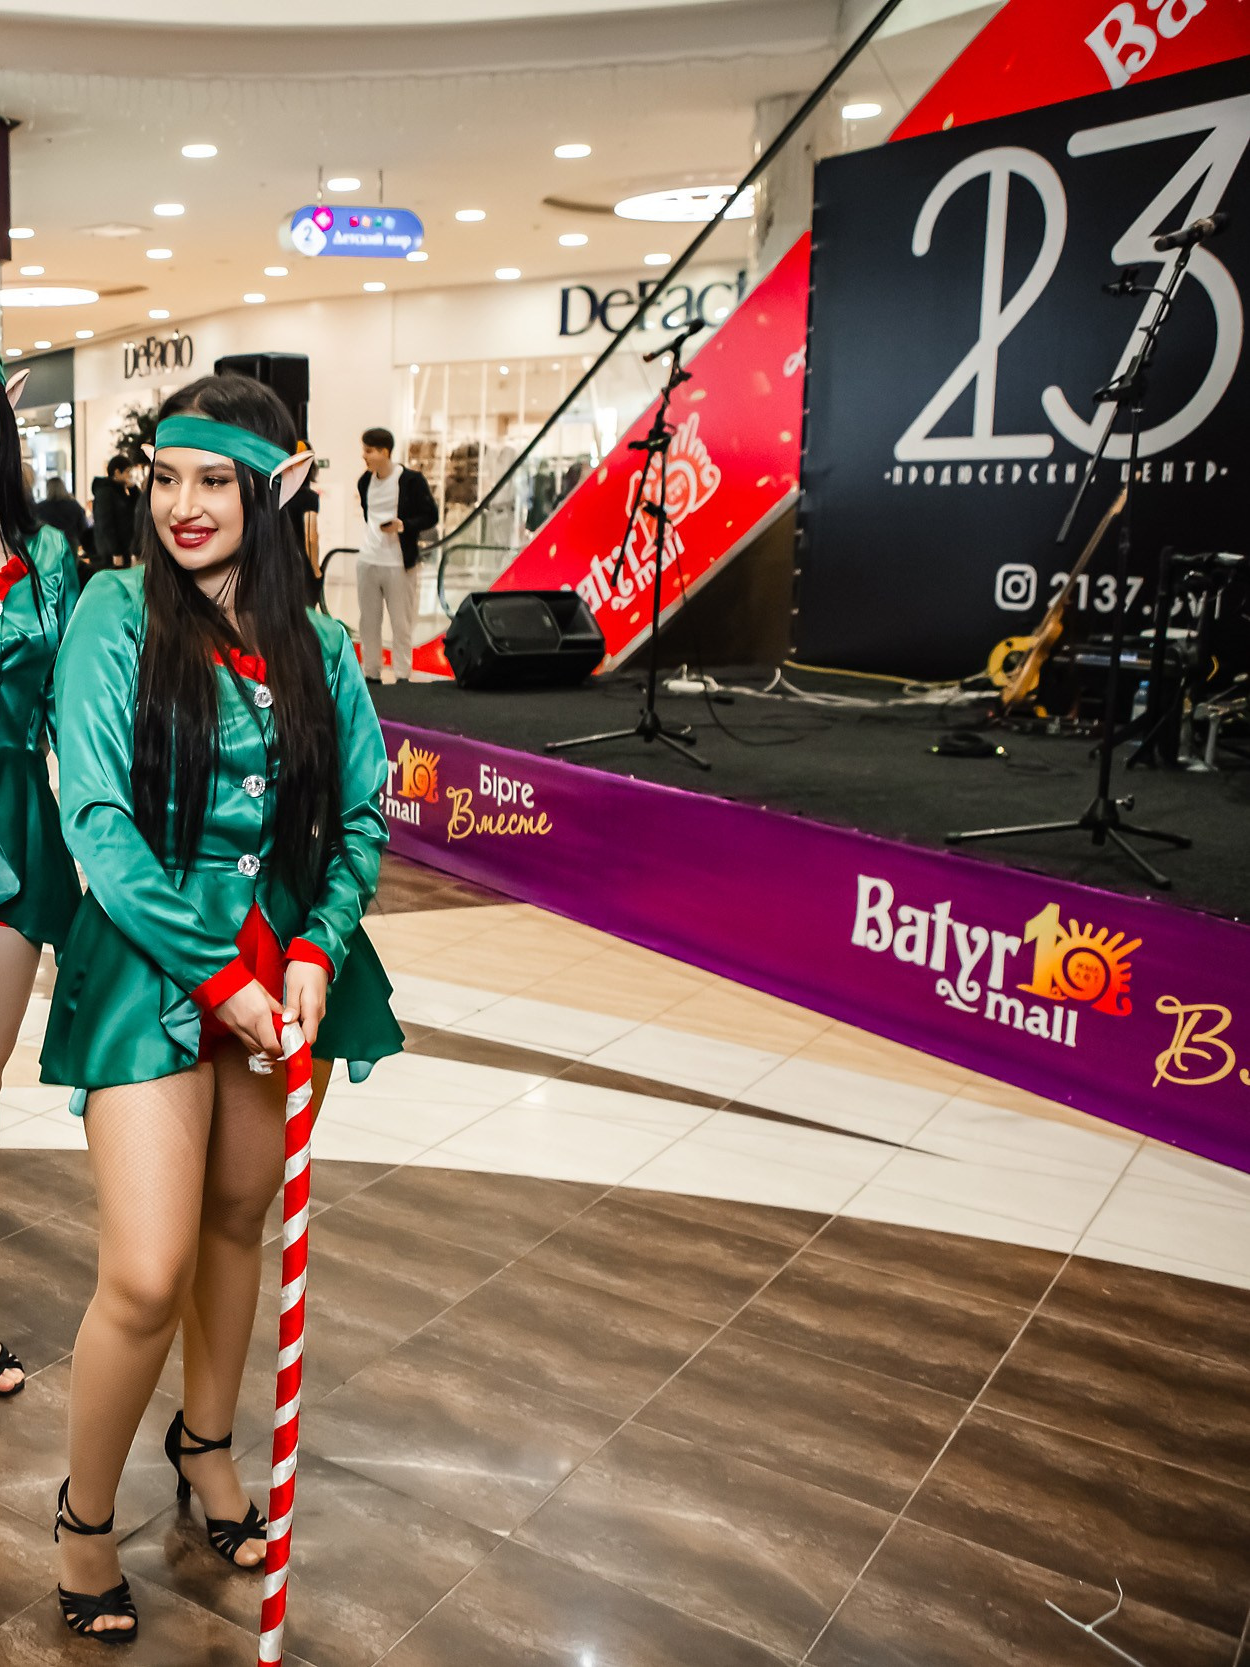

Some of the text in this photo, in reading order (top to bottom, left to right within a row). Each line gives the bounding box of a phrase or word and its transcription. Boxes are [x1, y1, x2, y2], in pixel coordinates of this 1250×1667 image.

[386, 797, 421, 826] mall
[445, 785, 553, 843] Вместе
[479, 763, 535, 809] Бірге
[851, 874, 1022, 1014] Batyr
[983, 990, 1079, 1048] mall
